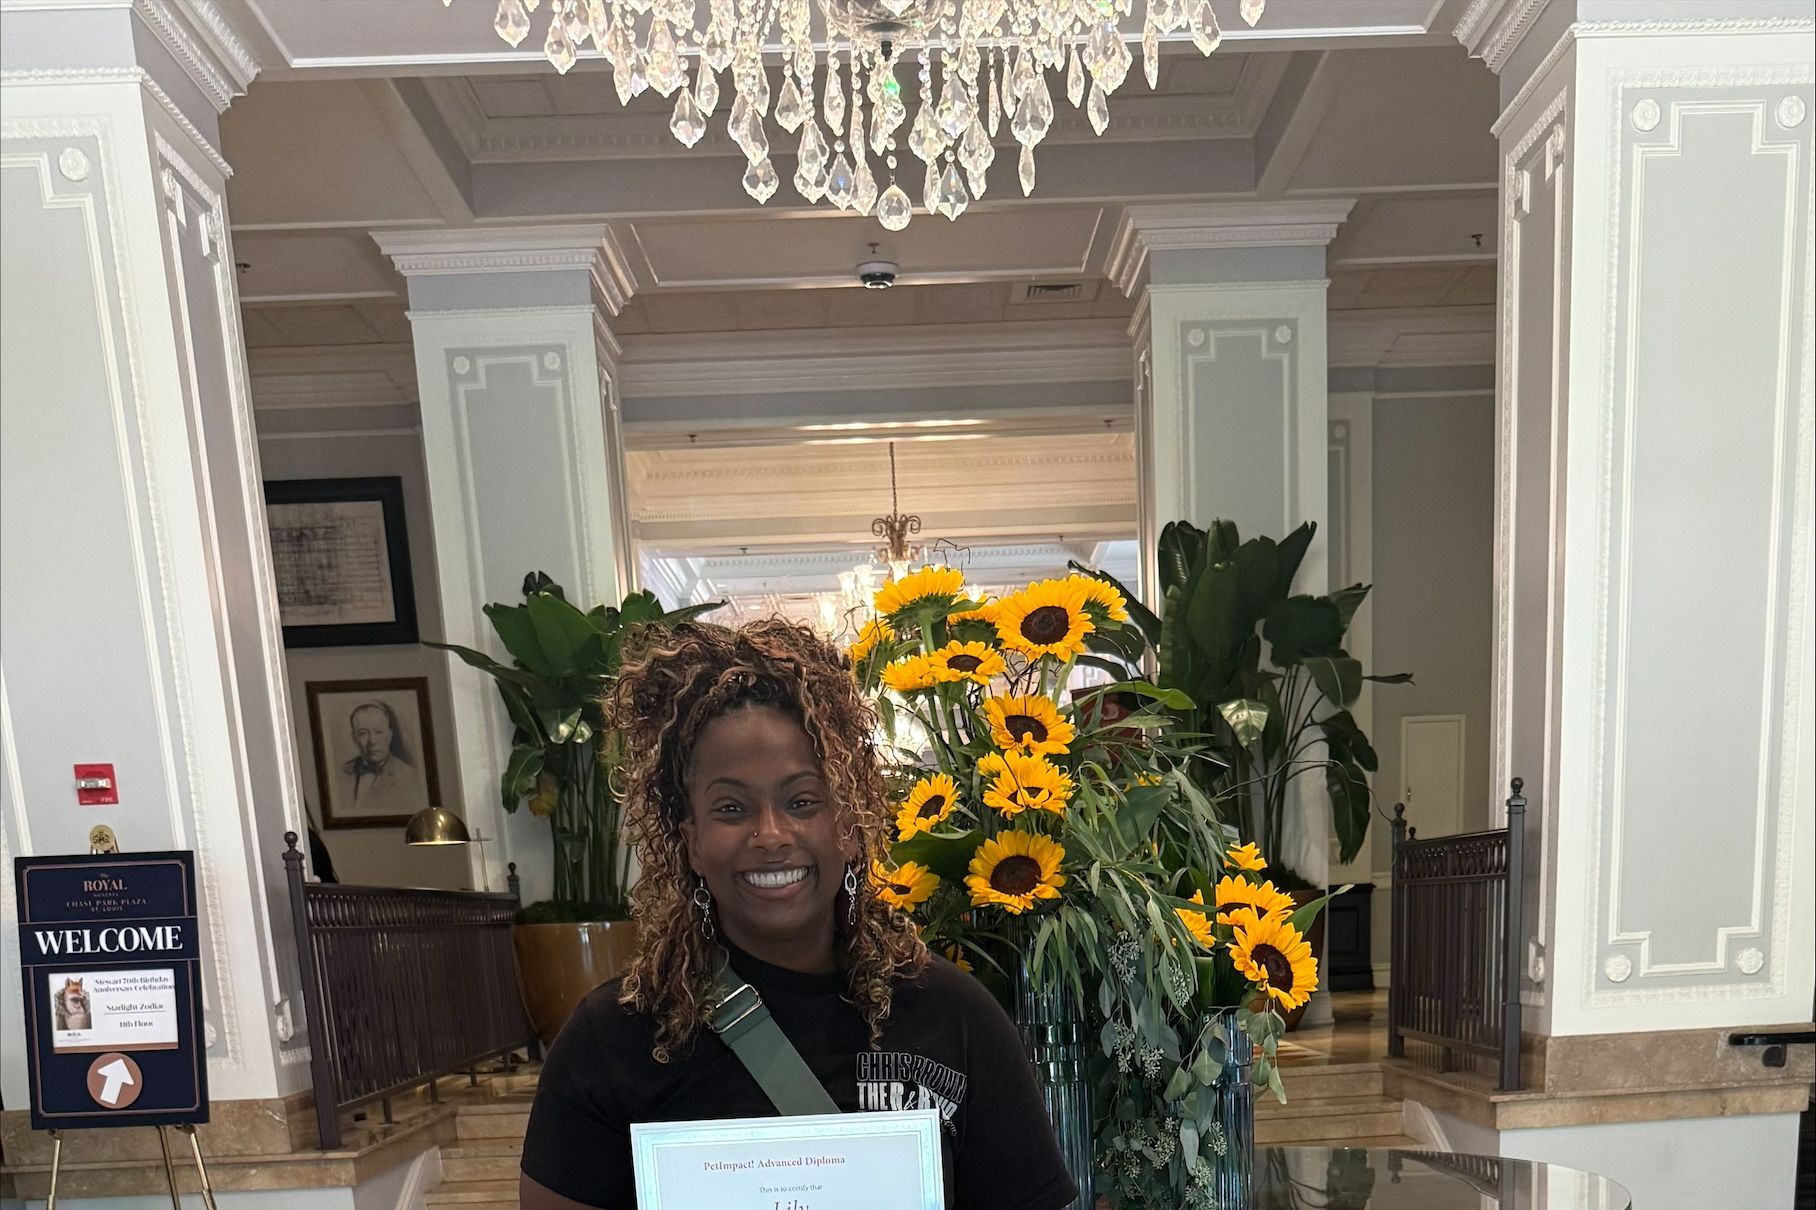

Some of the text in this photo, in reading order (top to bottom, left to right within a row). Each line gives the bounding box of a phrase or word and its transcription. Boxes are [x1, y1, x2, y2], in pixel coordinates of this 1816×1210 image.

[83, 879, 128, 892] ROYAL
[96, 899, 118, 907] PARK
[34, 926, 183, 955] WELCOME
[856, 1052, 912, 1082] CHRIS
[912, 1054, 968, 1104] BROWN
[856, 1082, 888, 1110] THE
[704, 1155, 846, 1172] PetImpact! Advanced Diploma
